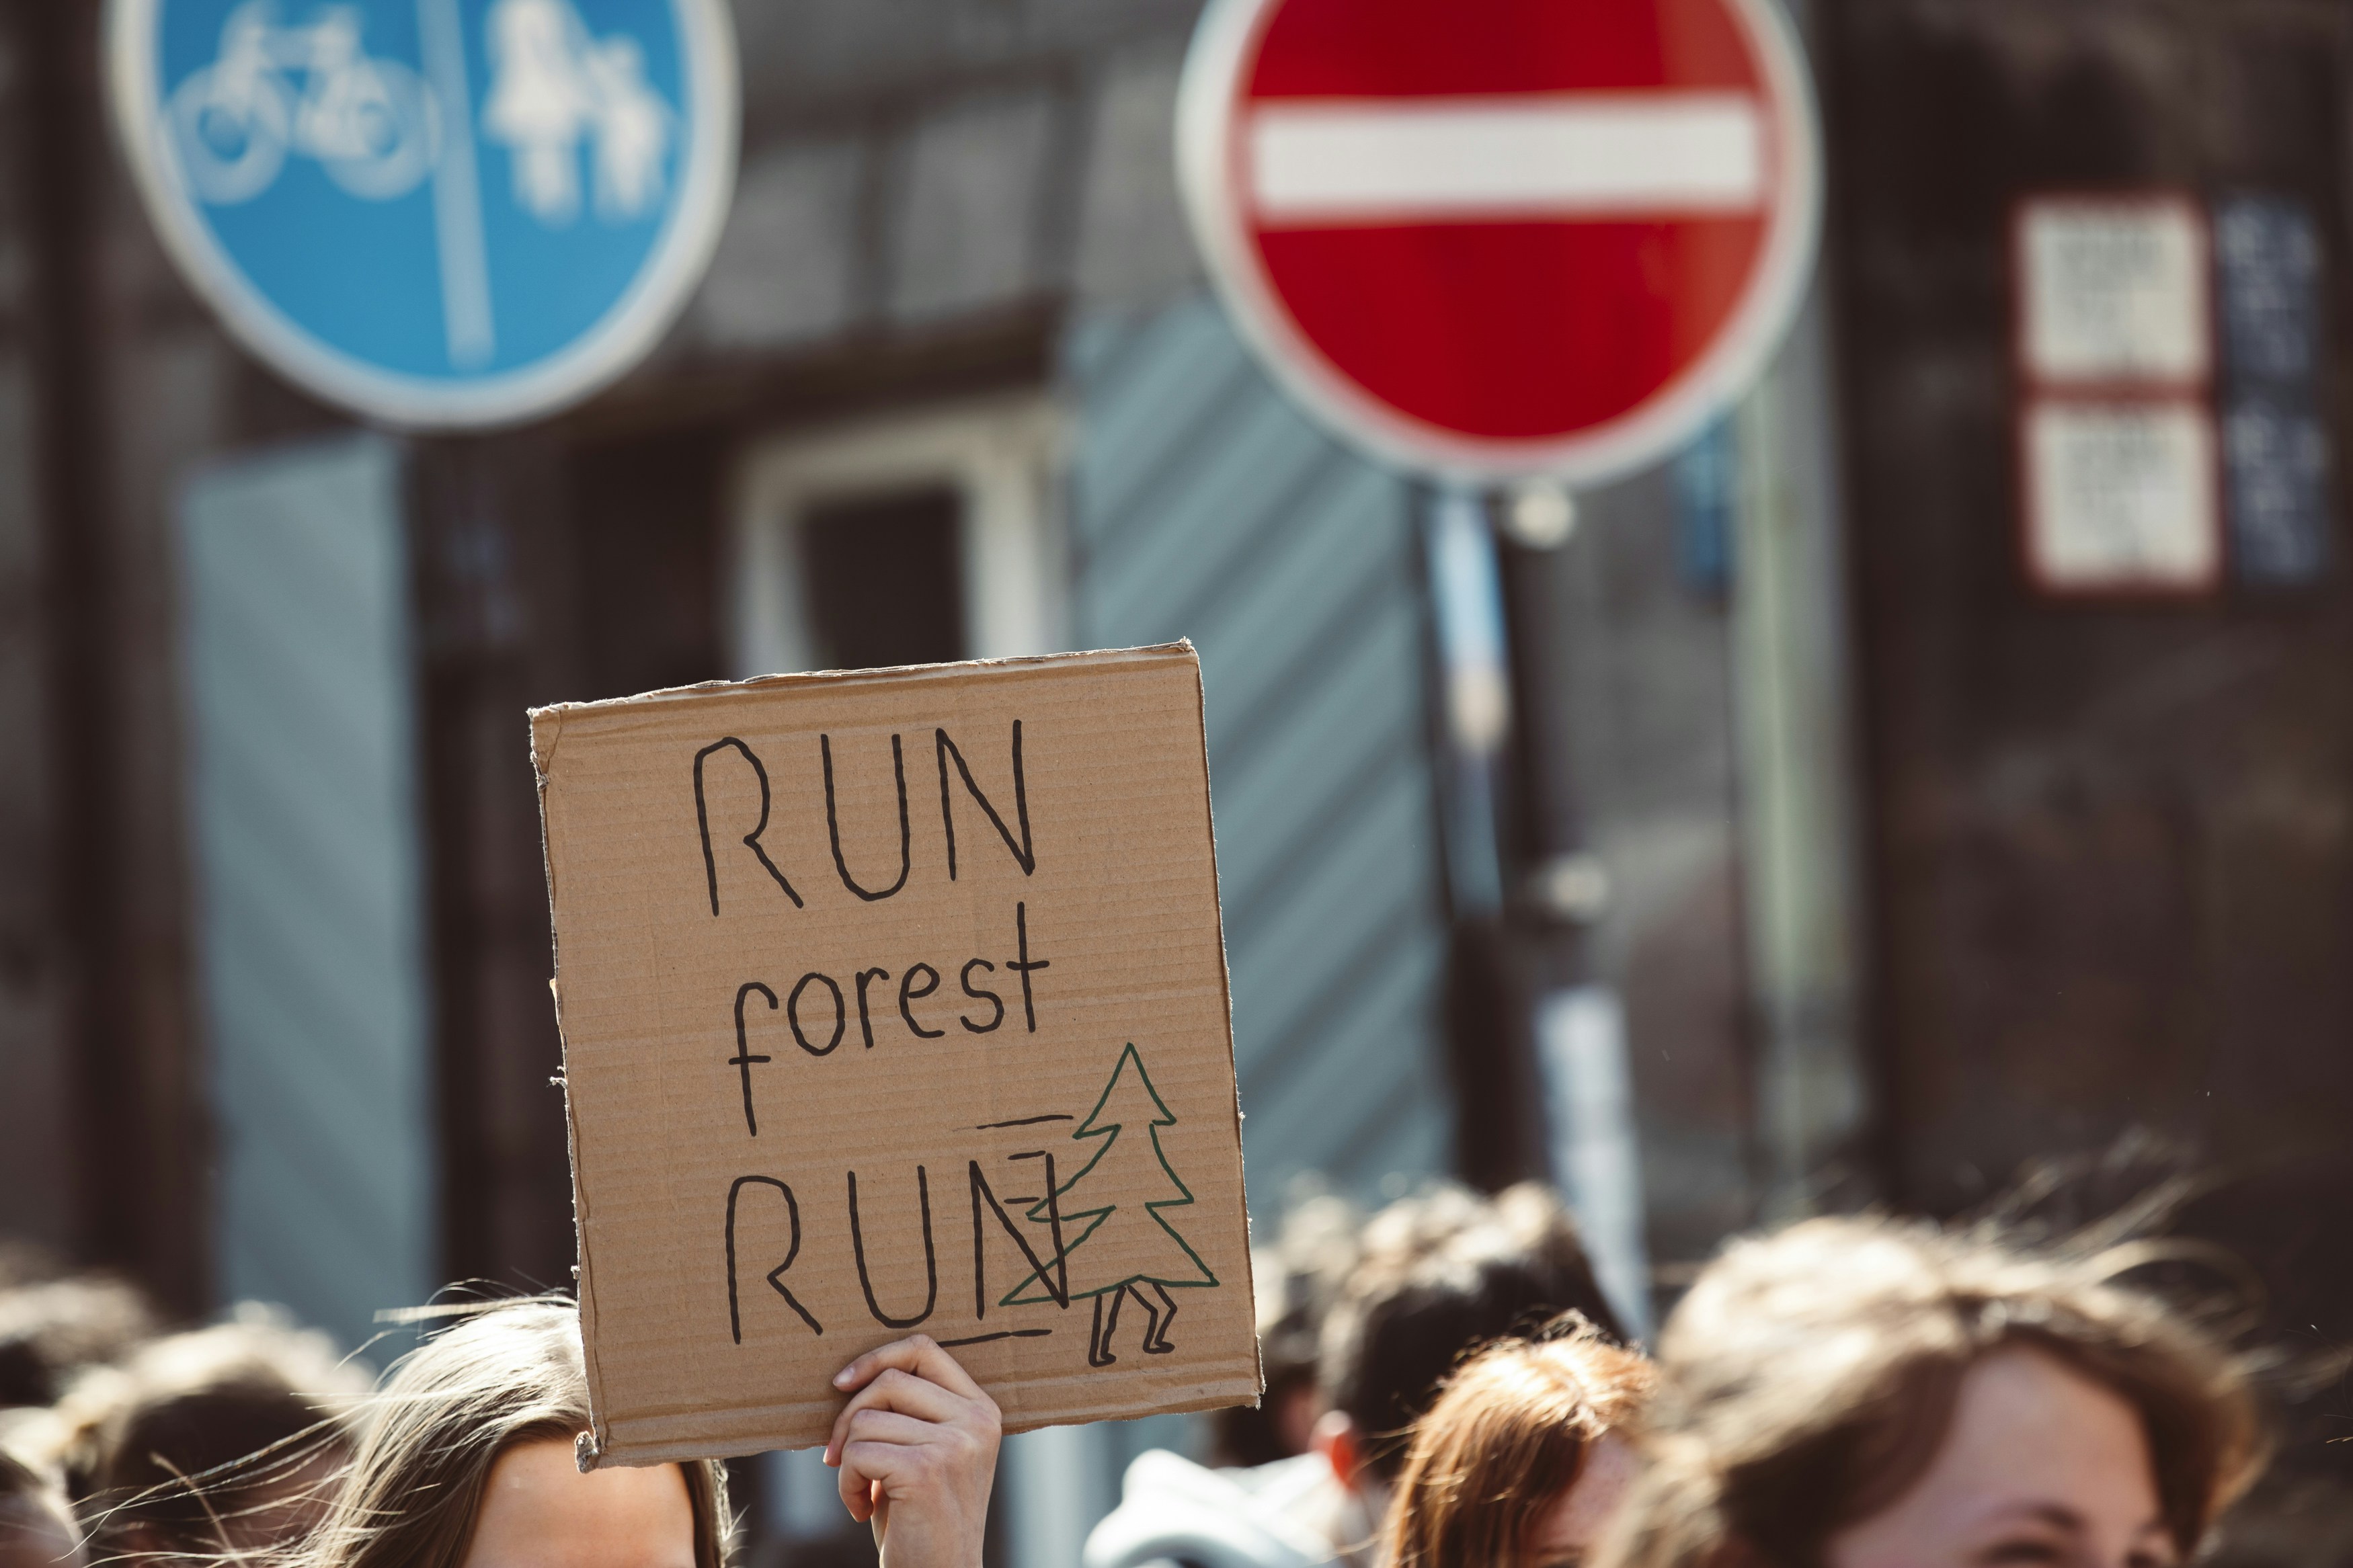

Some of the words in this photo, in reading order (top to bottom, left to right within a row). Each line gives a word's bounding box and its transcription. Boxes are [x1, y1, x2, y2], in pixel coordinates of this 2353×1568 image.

[694, 720, 1035, 916] RUN
[729, 903, 1050, 1137] forest
[727, 1153, 1070, 1344] RUN
